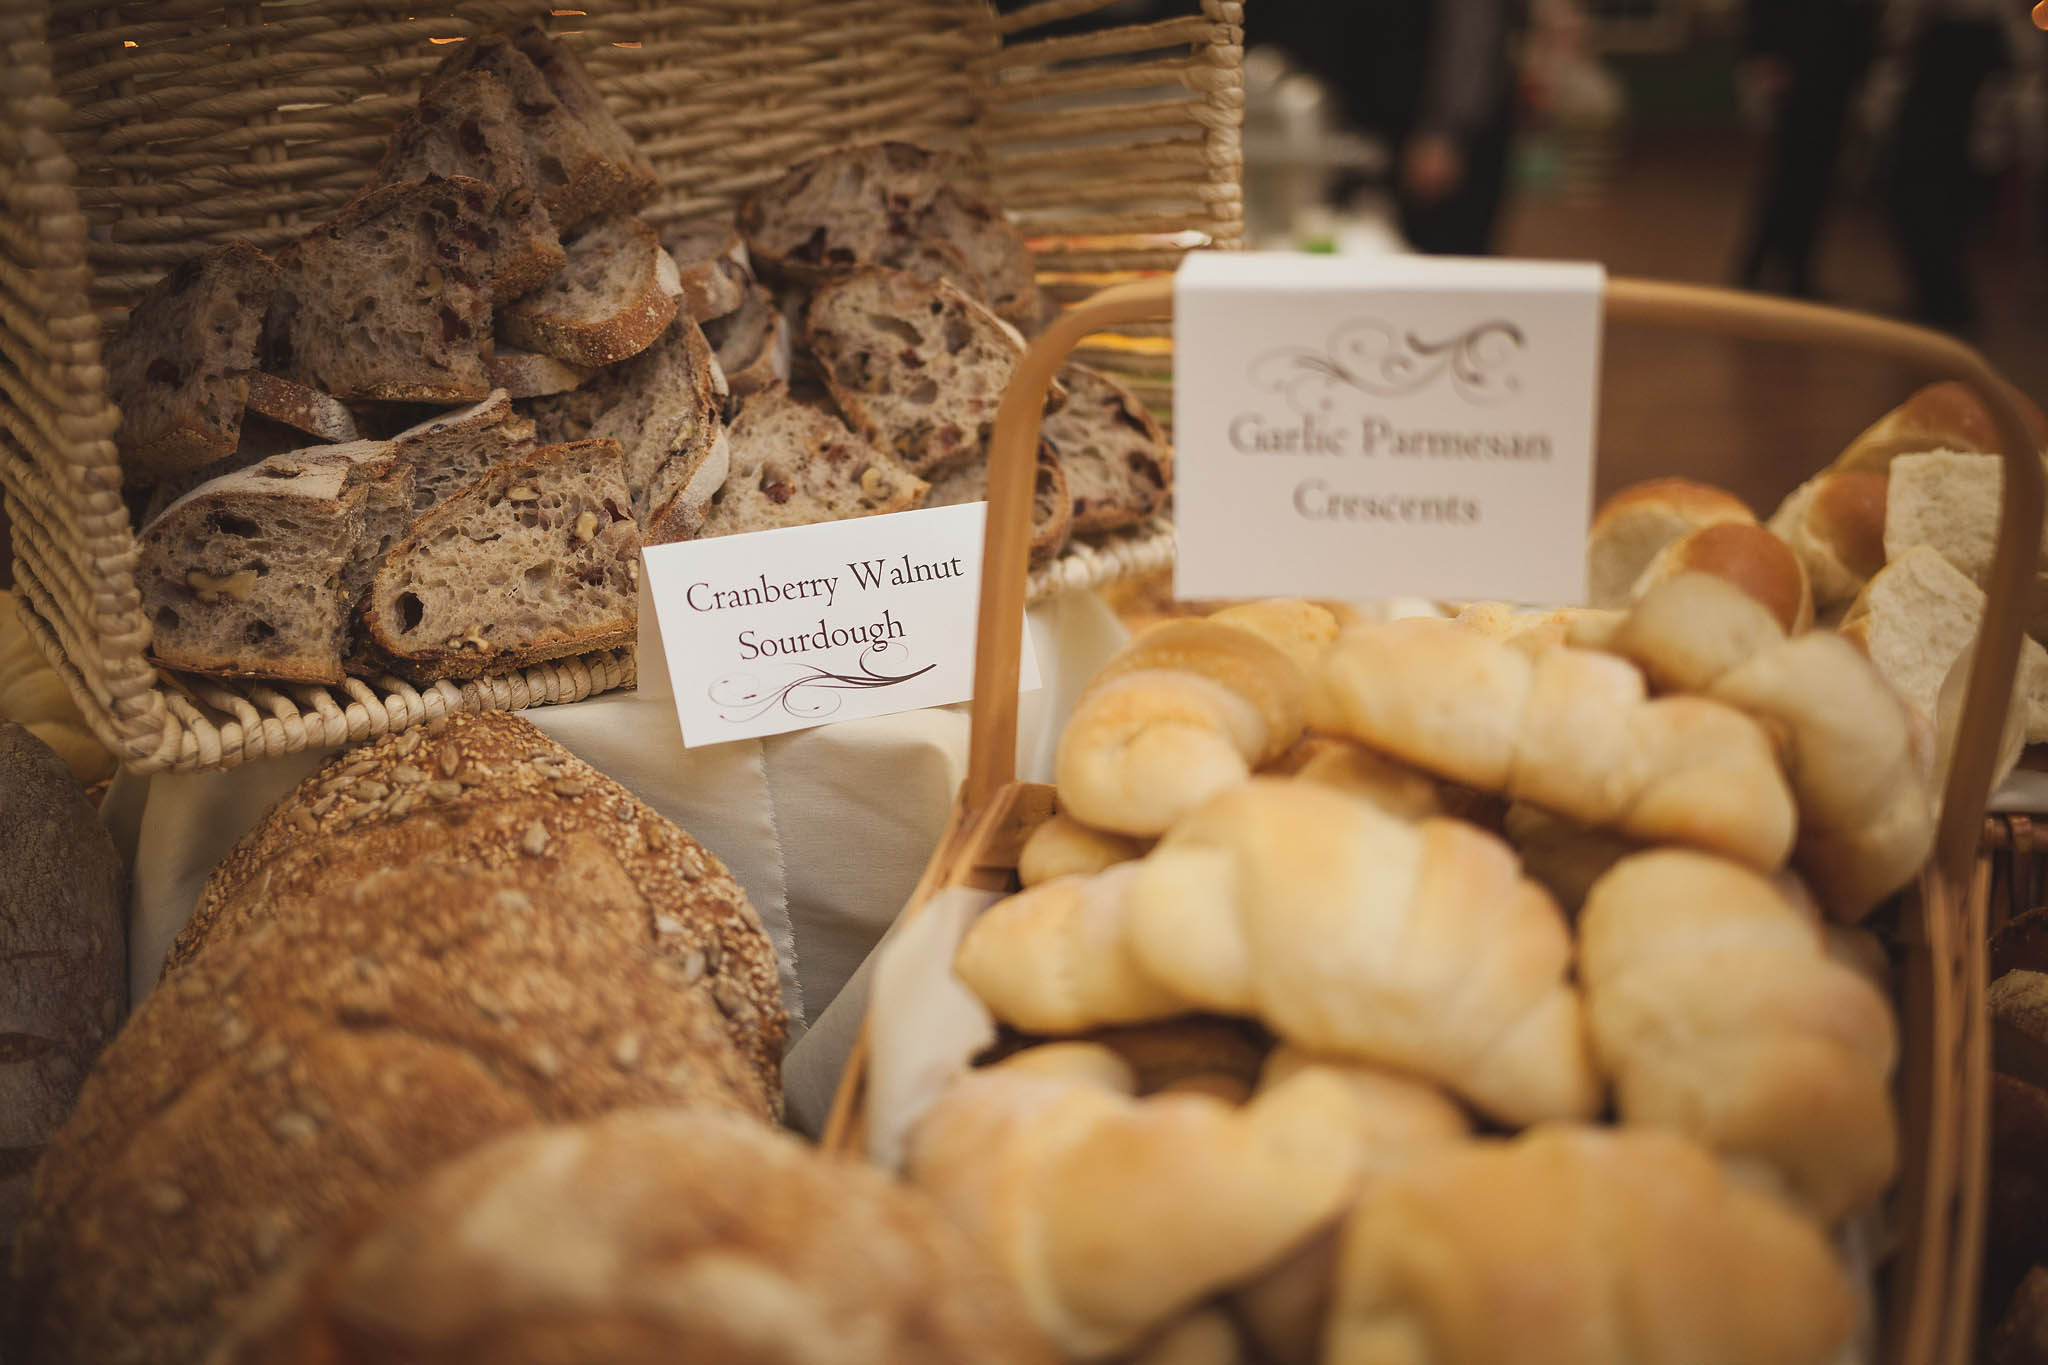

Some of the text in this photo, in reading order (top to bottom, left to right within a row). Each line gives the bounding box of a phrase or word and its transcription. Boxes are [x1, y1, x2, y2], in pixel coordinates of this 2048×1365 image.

[1229, 413, 1553, 461] Garlic Parmesan
[1292, 477, 1482, 524] Crescents
[686, 554, 964, 612] Cranberry Walnut
[738, 609, 906, 661] Sourdough
